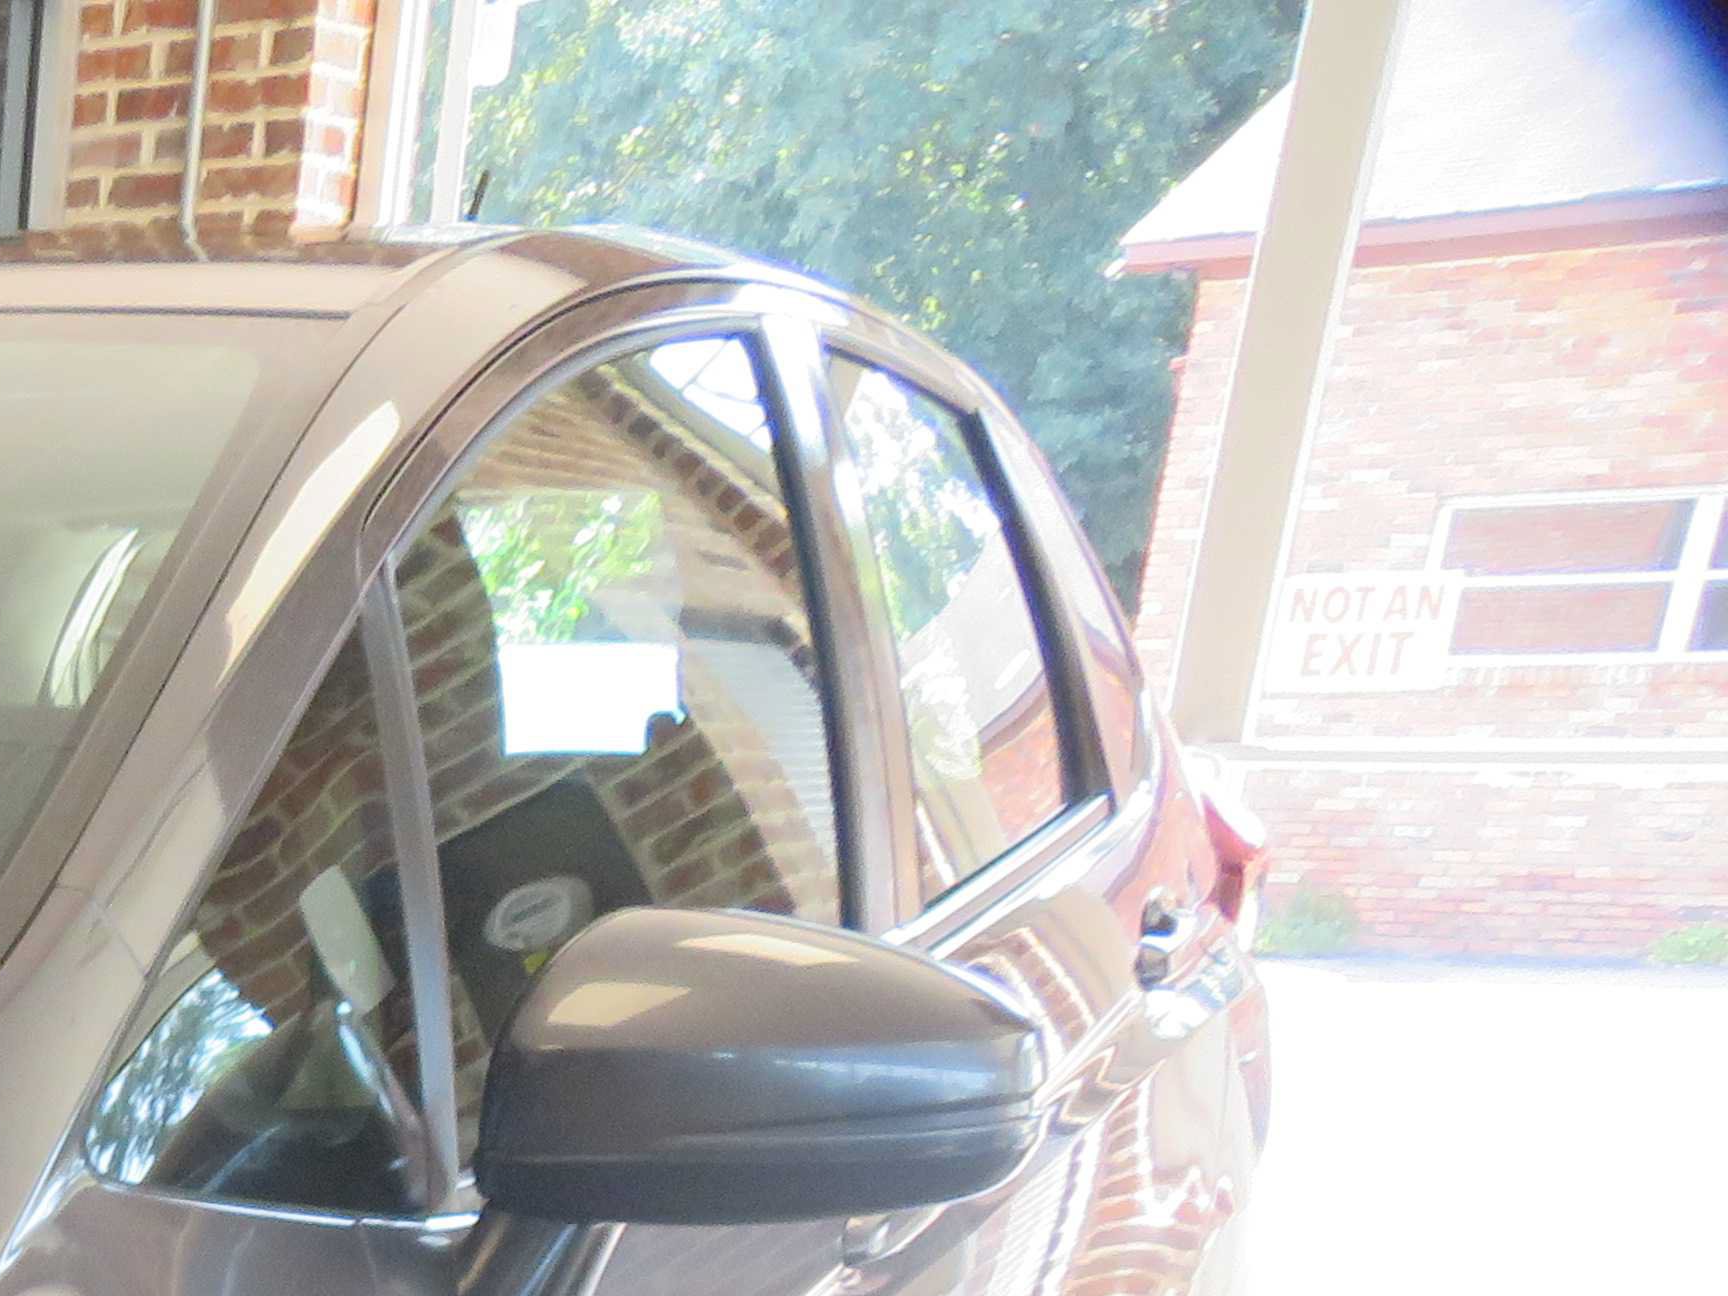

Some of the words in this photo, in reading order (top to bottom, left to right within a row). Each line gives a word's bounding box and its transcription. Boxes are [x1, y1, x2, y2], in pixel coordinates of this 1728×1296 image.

[1289, 586, 1376, 623] NOT
[1383, 584, 1445, 622] AN
[1300, 632, 1415, 677] EXIT
